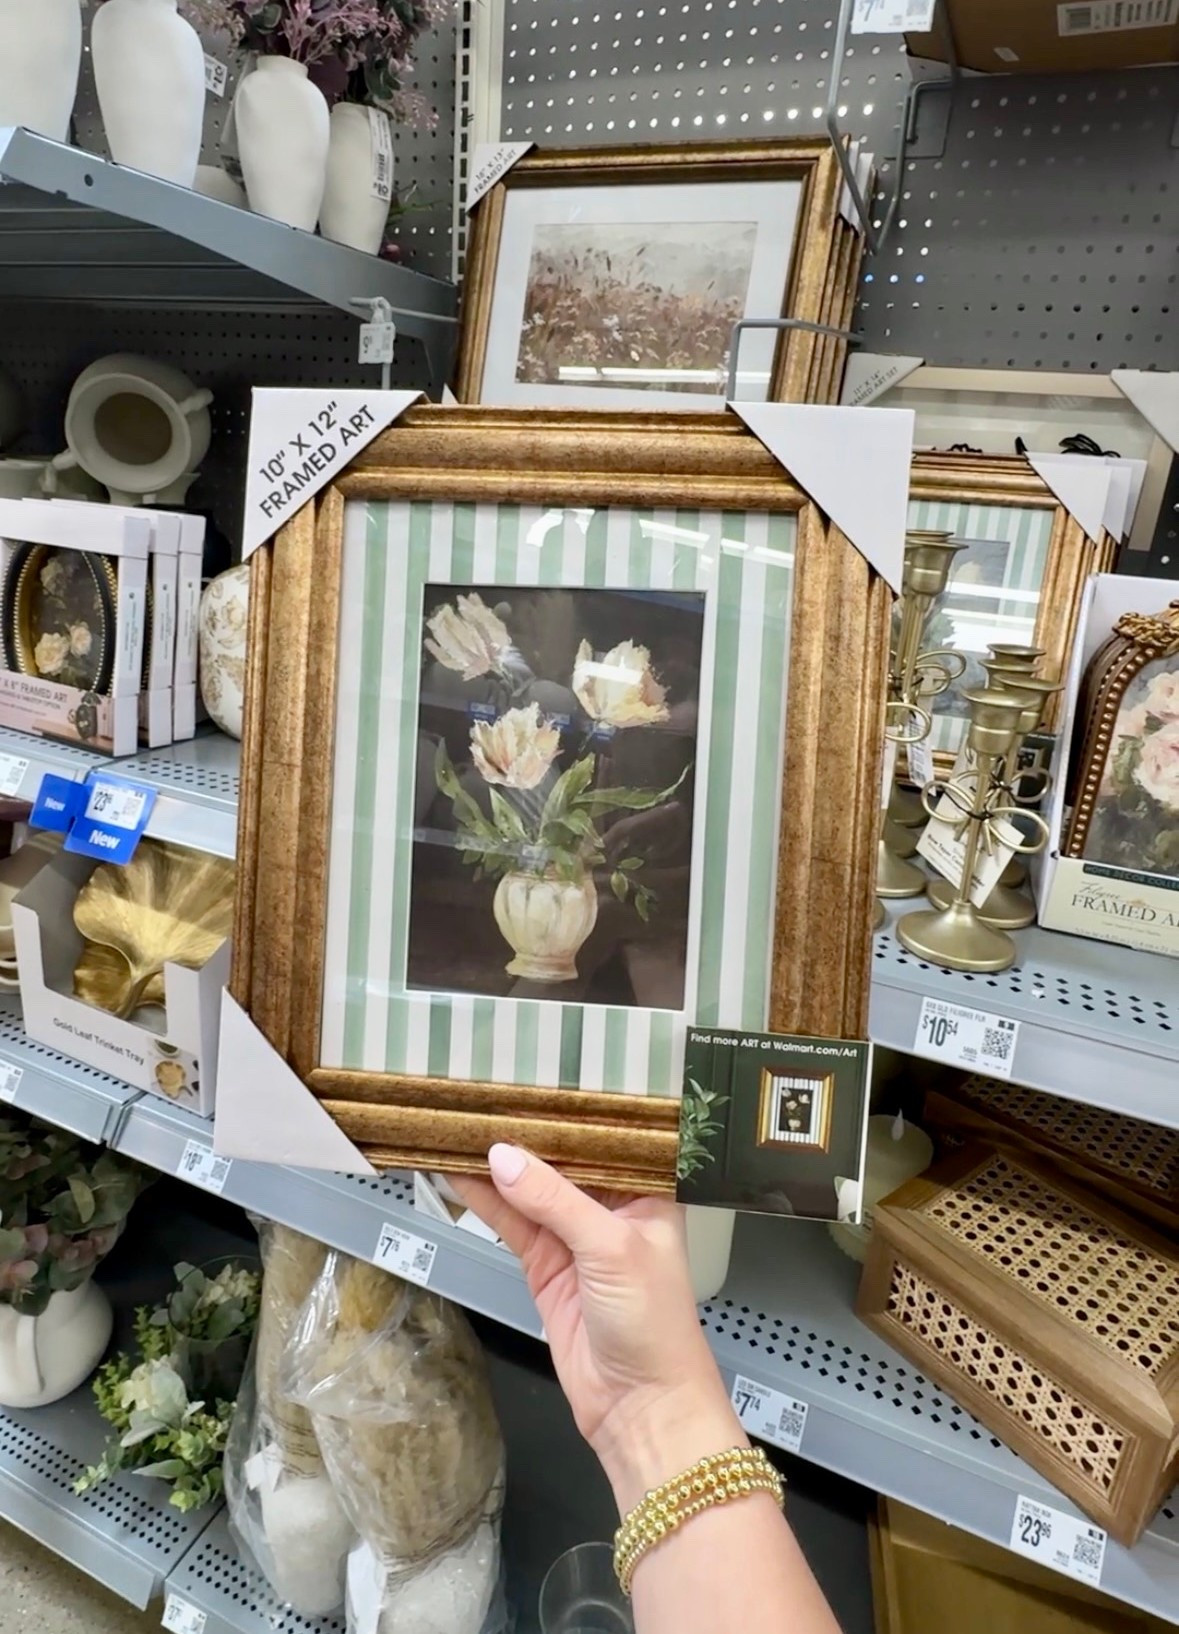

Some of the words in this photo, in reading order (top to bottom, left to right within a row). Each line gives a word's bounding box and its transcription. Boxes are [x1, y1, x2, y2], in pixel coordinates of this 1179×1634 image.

[474, 163, 503, 194] FRAMED
[503, 149, 516, 165] ART
[874, 375, 887, 389] ART
[886, 366, 899, 378] SET
[258, 450, 286, 484] 10"
[289, 433, 312, 456] X
[307, 401, 338, 436] 12"
[258, 442, 337, 519] FRAMED
[339, 404, 376, 447] ART
[21, 682, 52, 699] FRAMED
[53, 691, 68, 703] ART
[44, 796, 66, 812] New
[88, 829, 121, 850] New
[1072, 893, 1157, 922] FRAMED
[1161, 912, 1179, 928] A
[53, 1017, 73, 1033] Gold
[74, 1026, 92, 1040] Leaf
[94, 1035, 124, 1055] Trinket
[125, 1048, 144, 1066] Tray
[690, 1033, 711, 1044] Find
[712, 1036, 738, 1046] more
[740, 1038, 758, 1048] ART
[761, 1040, 771, 1049] at
[773, 1041, 858, 1057] Walmart.com/Art
